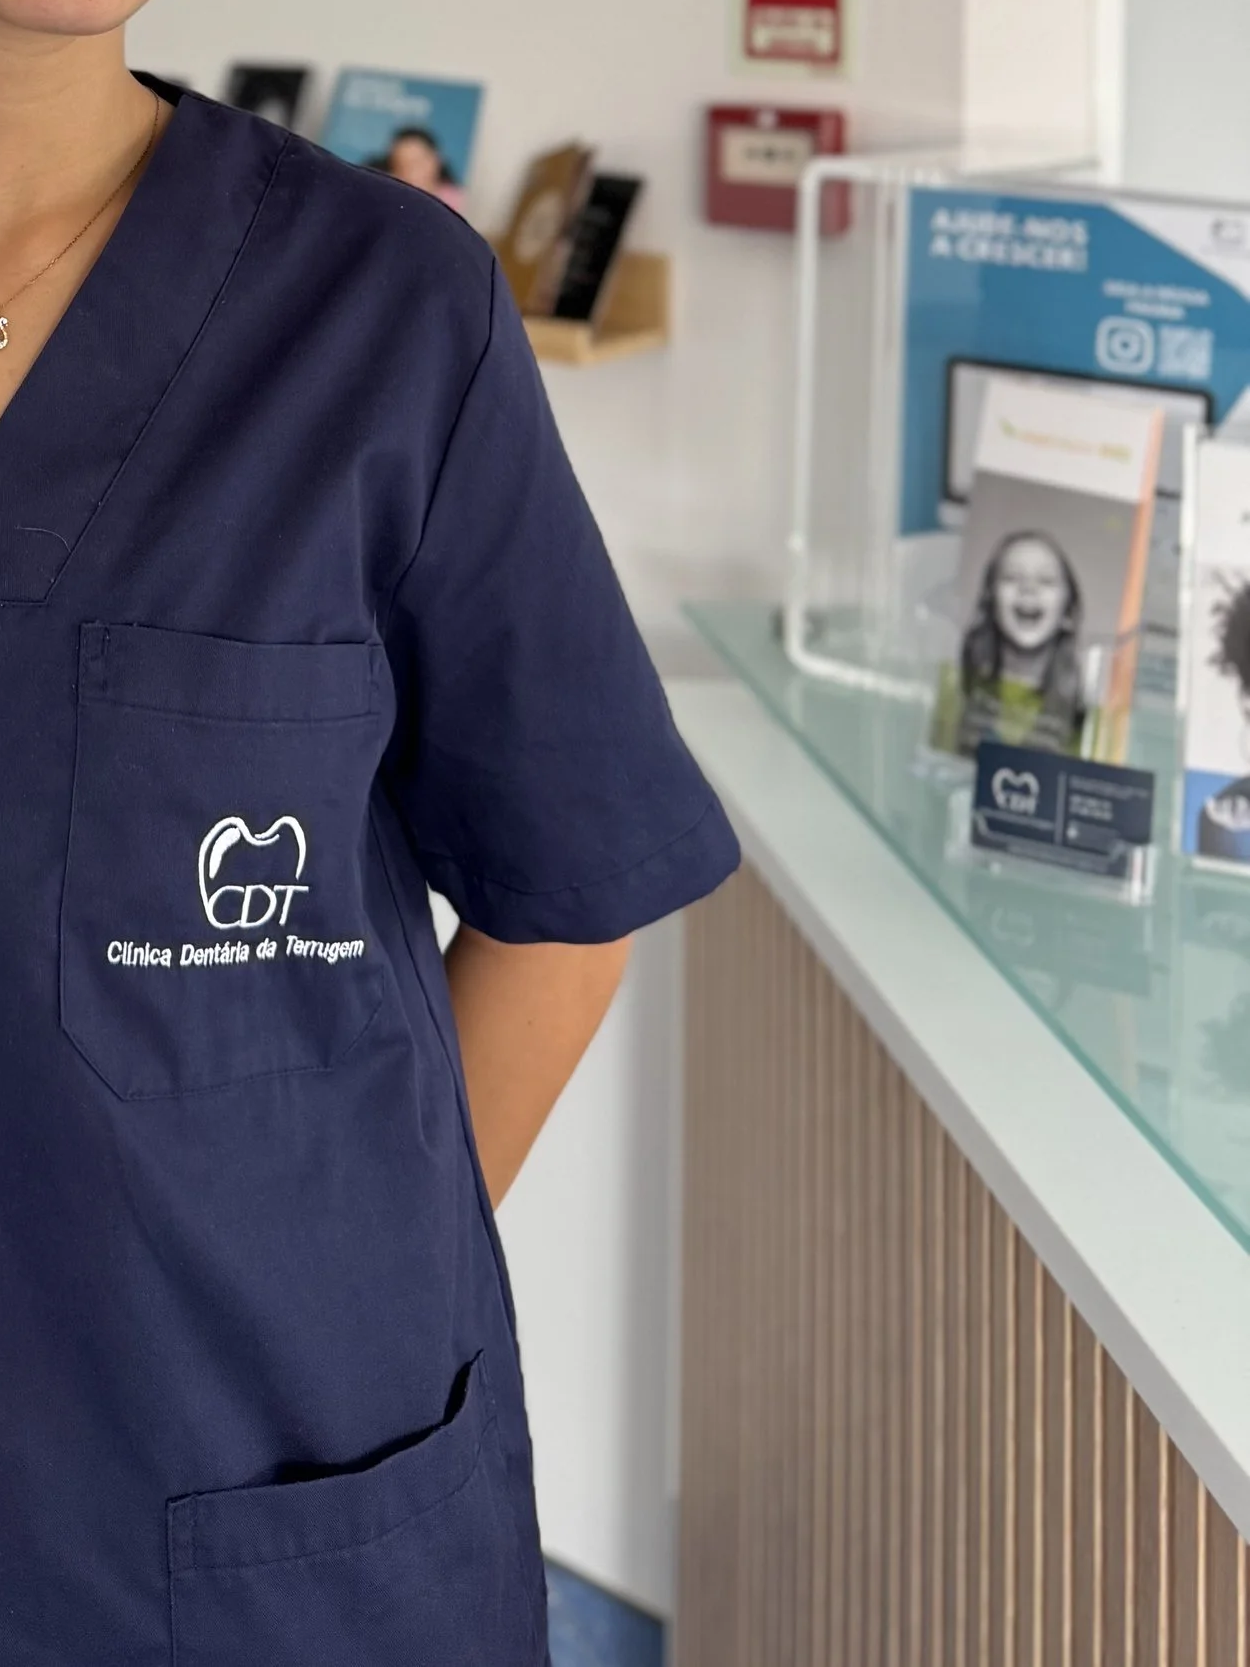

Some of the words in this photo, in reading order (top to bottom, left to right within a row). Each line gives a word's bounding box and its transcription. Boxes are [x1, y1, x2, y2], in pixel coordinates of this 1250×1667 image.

[207, 884, 309, 929] CDT
[107, 940, 171, 967] Clínica
[180, 940, 249, 966] Dentária
[256, 937, 278, 960] da
[286, 935, 364, 965] Terrugem
